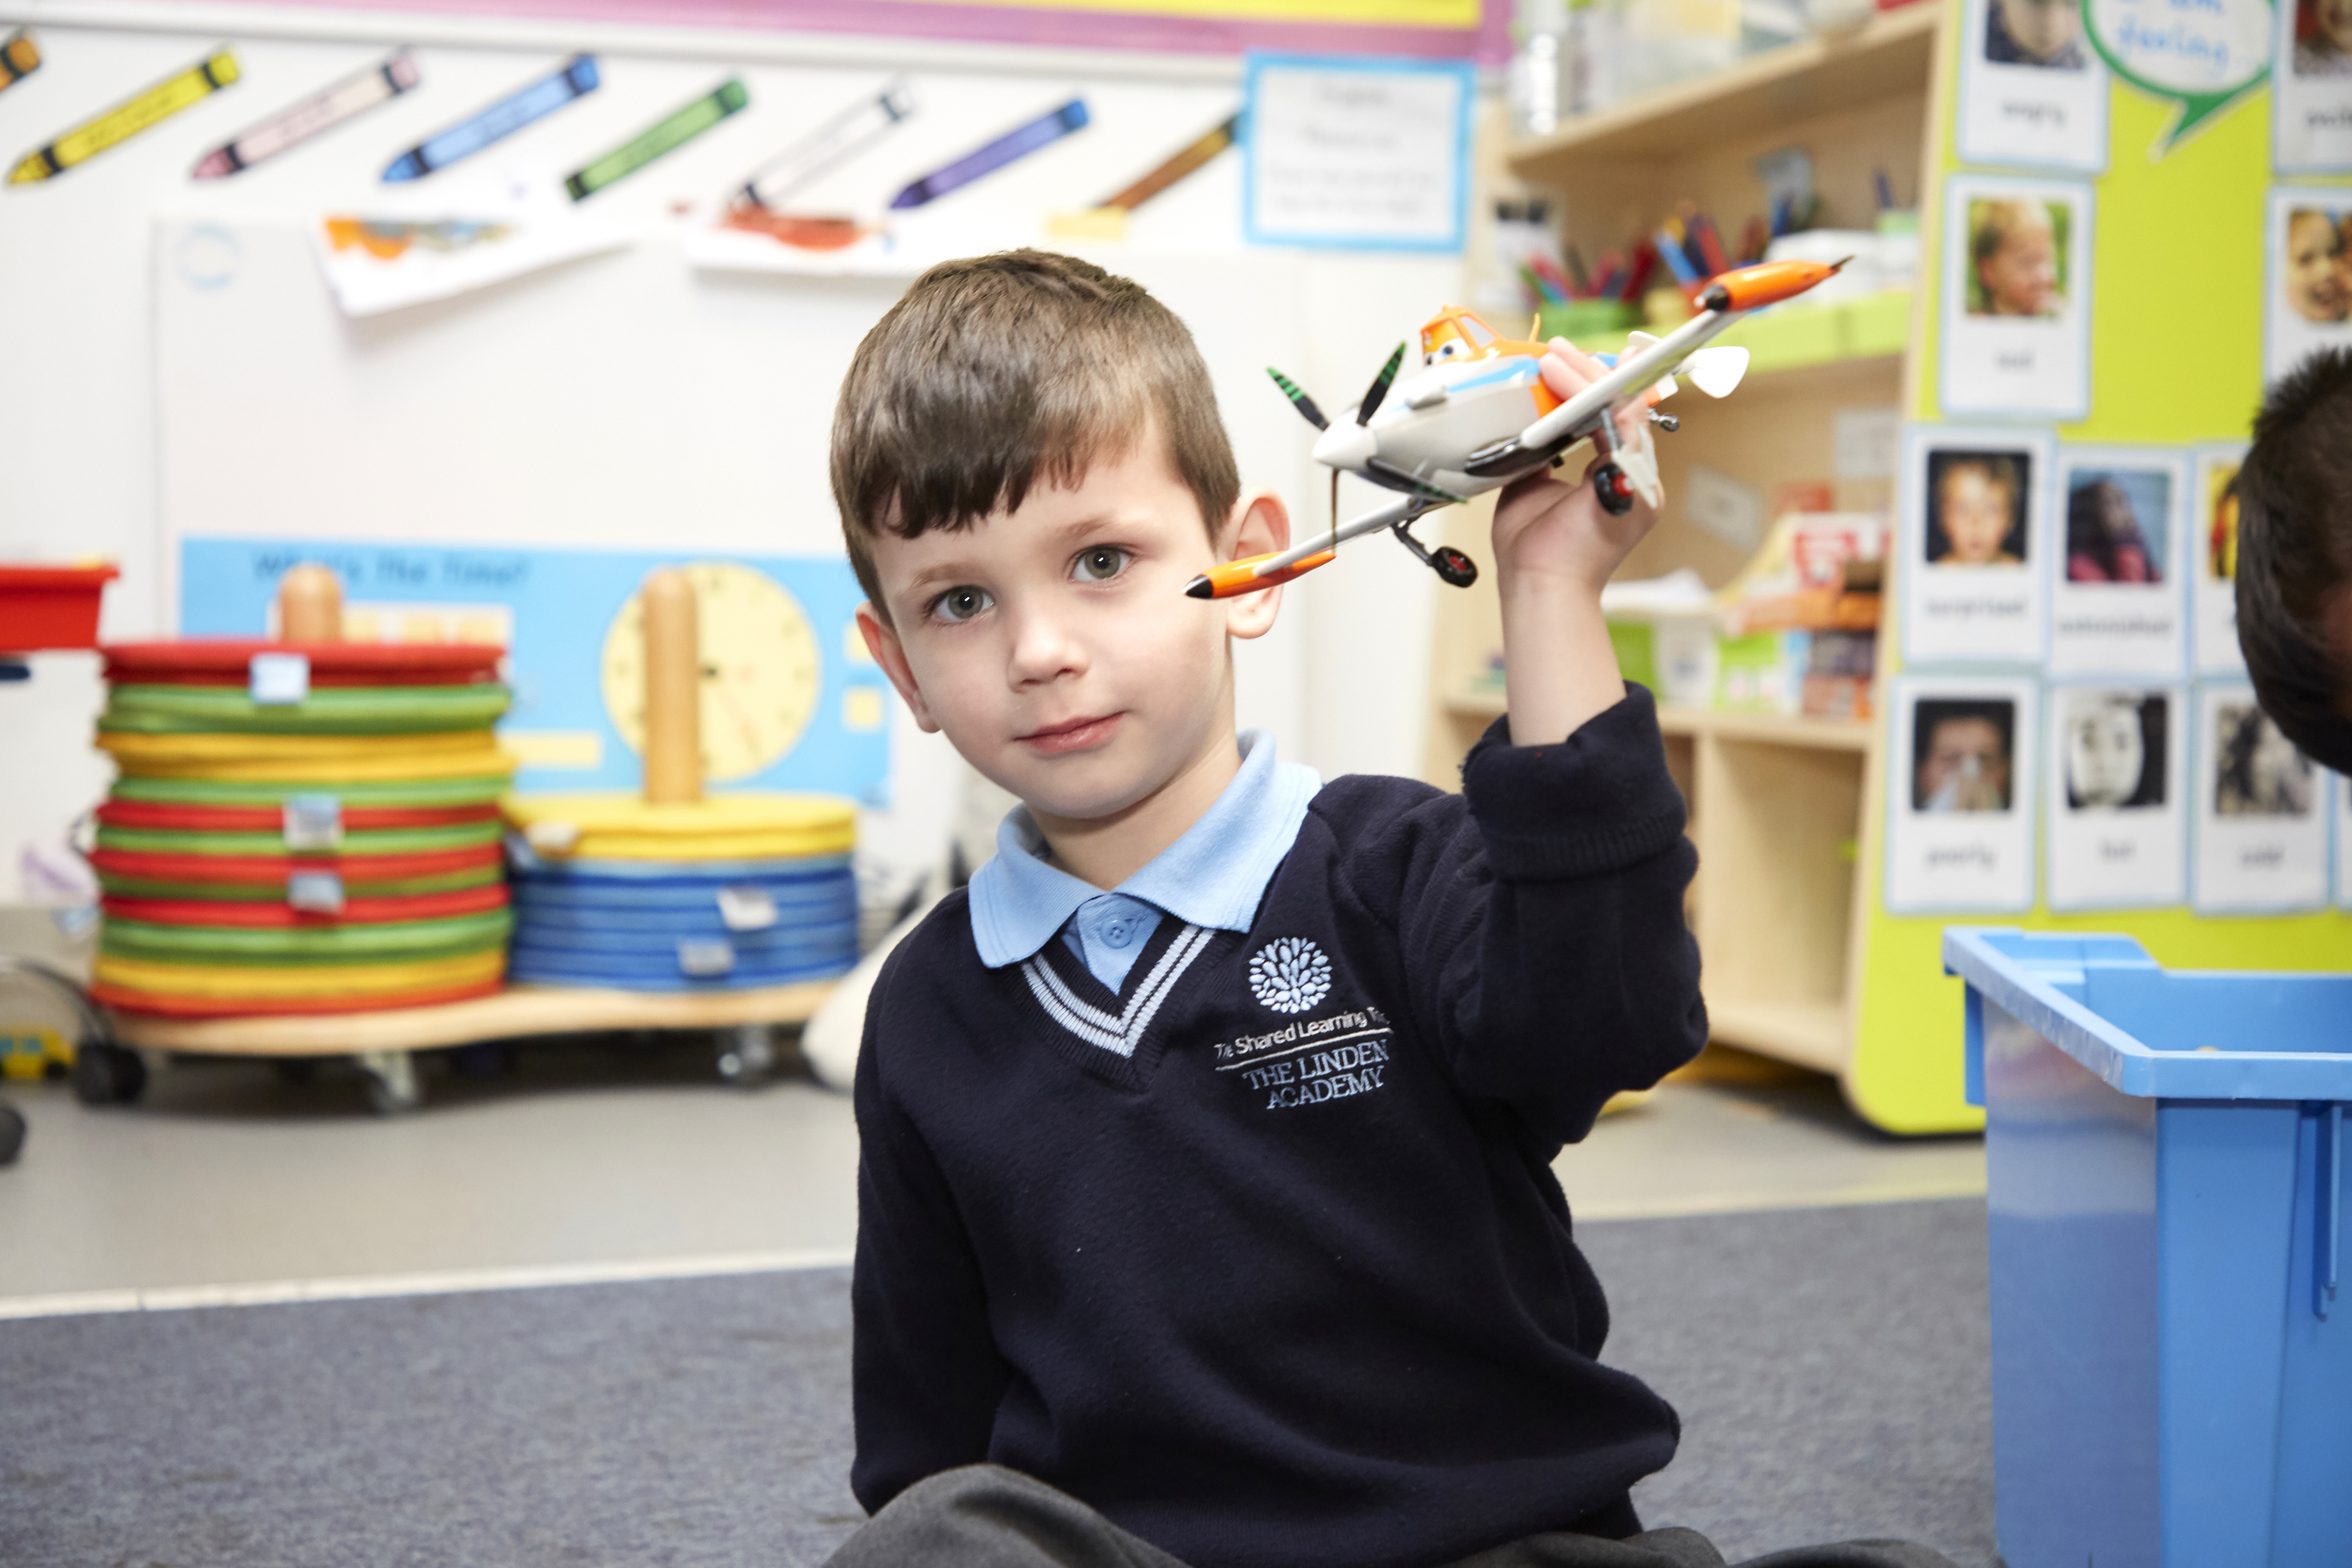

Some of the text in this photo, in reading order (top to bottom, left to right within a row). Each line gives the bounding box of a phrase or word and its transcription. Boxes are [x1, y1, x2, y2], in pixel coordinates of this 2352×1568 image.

[1235, 1022, 1297, 1055] Shared
[1297, 1010, 1368, 1038] Learning
[1242, 1039, 1389, 1090] THE LINDEN
[1266, 1065, 1385, 1110] ACADEMY
